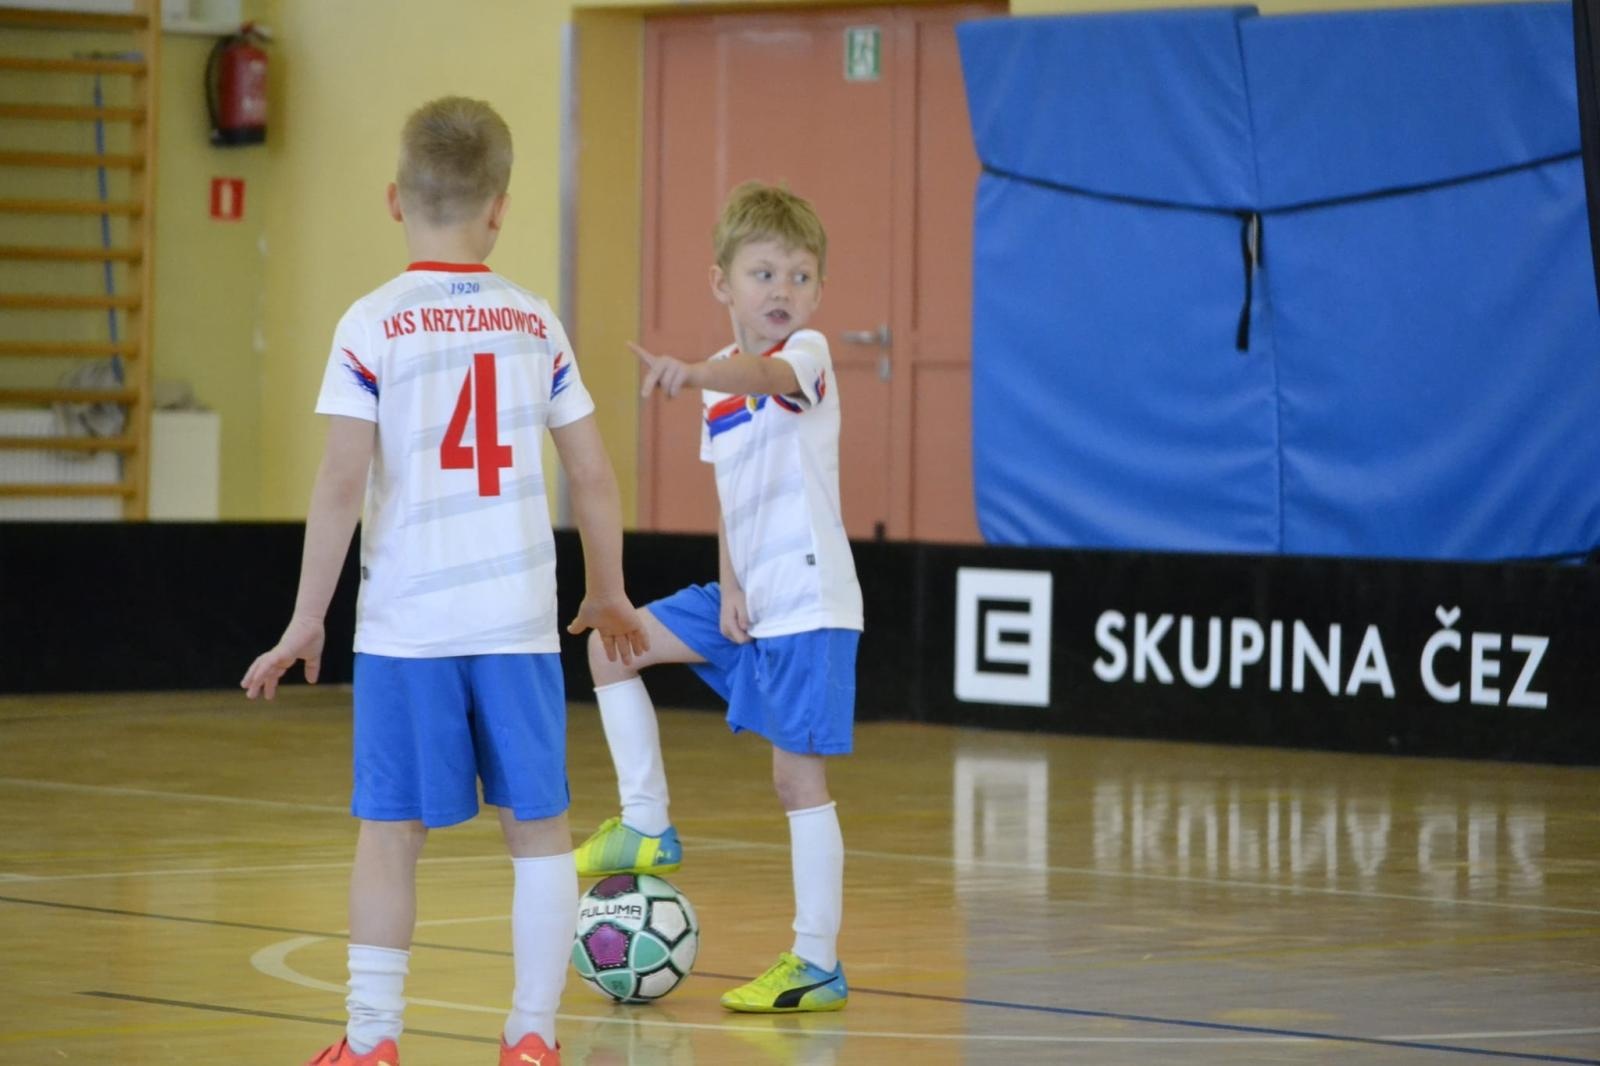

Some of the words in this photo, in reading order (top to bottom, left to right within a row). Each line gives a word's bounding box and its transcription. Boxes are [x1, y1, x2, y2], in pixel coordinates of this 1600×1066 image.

[383, 310, 416, 339] LKS
[420, 305, 547, 339] KRZYŻANOWICE
[450, 282, 480, 295] 1920
[440, 353, 513, 497] 4
[1093, 609, 1396, 698] SKUPINA
[1420, 604, 1549, 709] ČEZ
